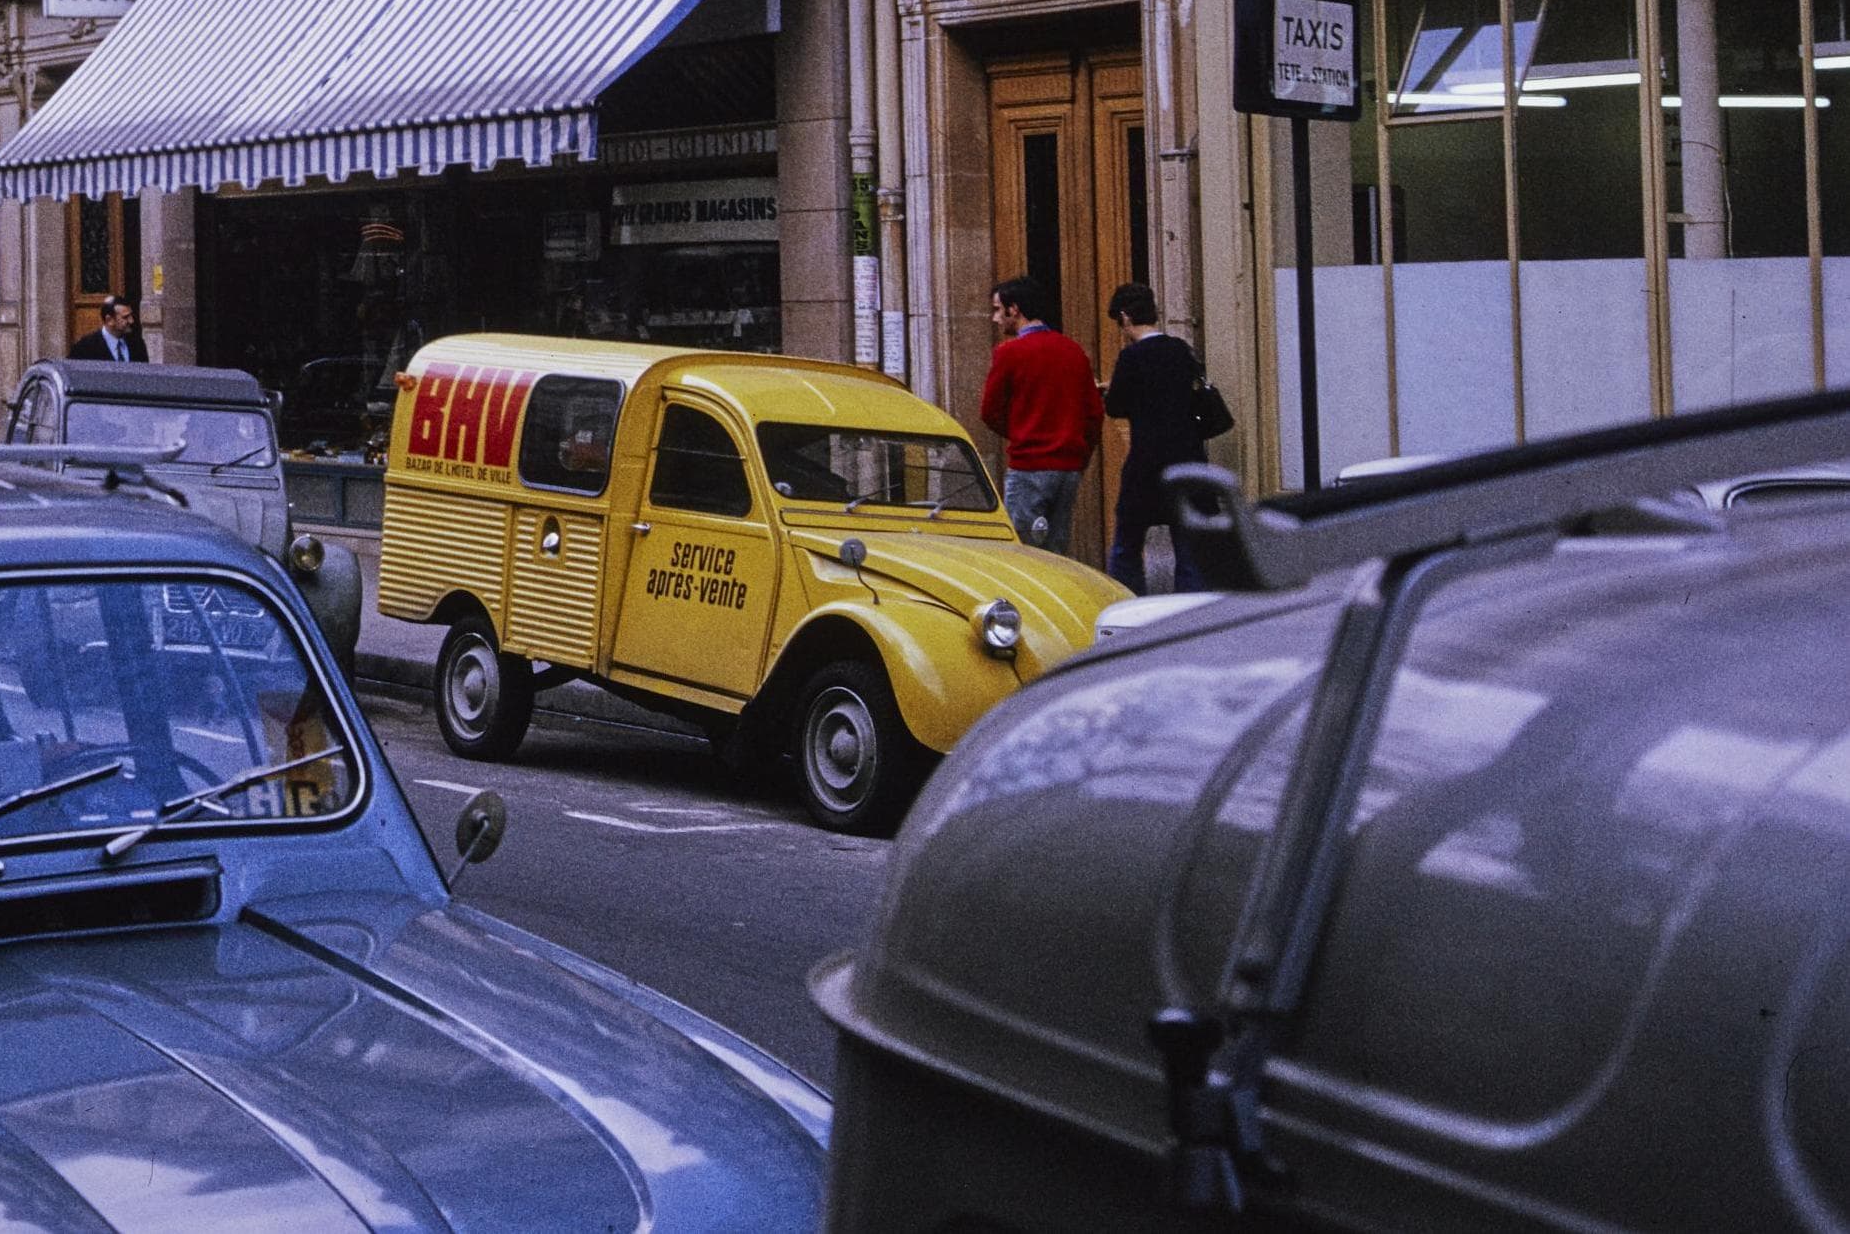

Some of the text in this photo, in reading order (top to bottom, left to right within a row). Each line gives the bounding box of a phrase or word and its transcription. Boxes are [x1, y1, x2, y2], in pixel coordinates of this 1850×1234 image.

[1282, 16, 1344, 51] TAXIS
[696, 197, 778, 223] MAGASINS
[407, 361, 538, 468] BHV
[406, 457, 432, 472] BAZAR
[434, 461, 444, 474] DE
[477, 468, 487, 482] DE
[490, 470, 511, 485] VILLE
[670, 541, 736, 576] service
